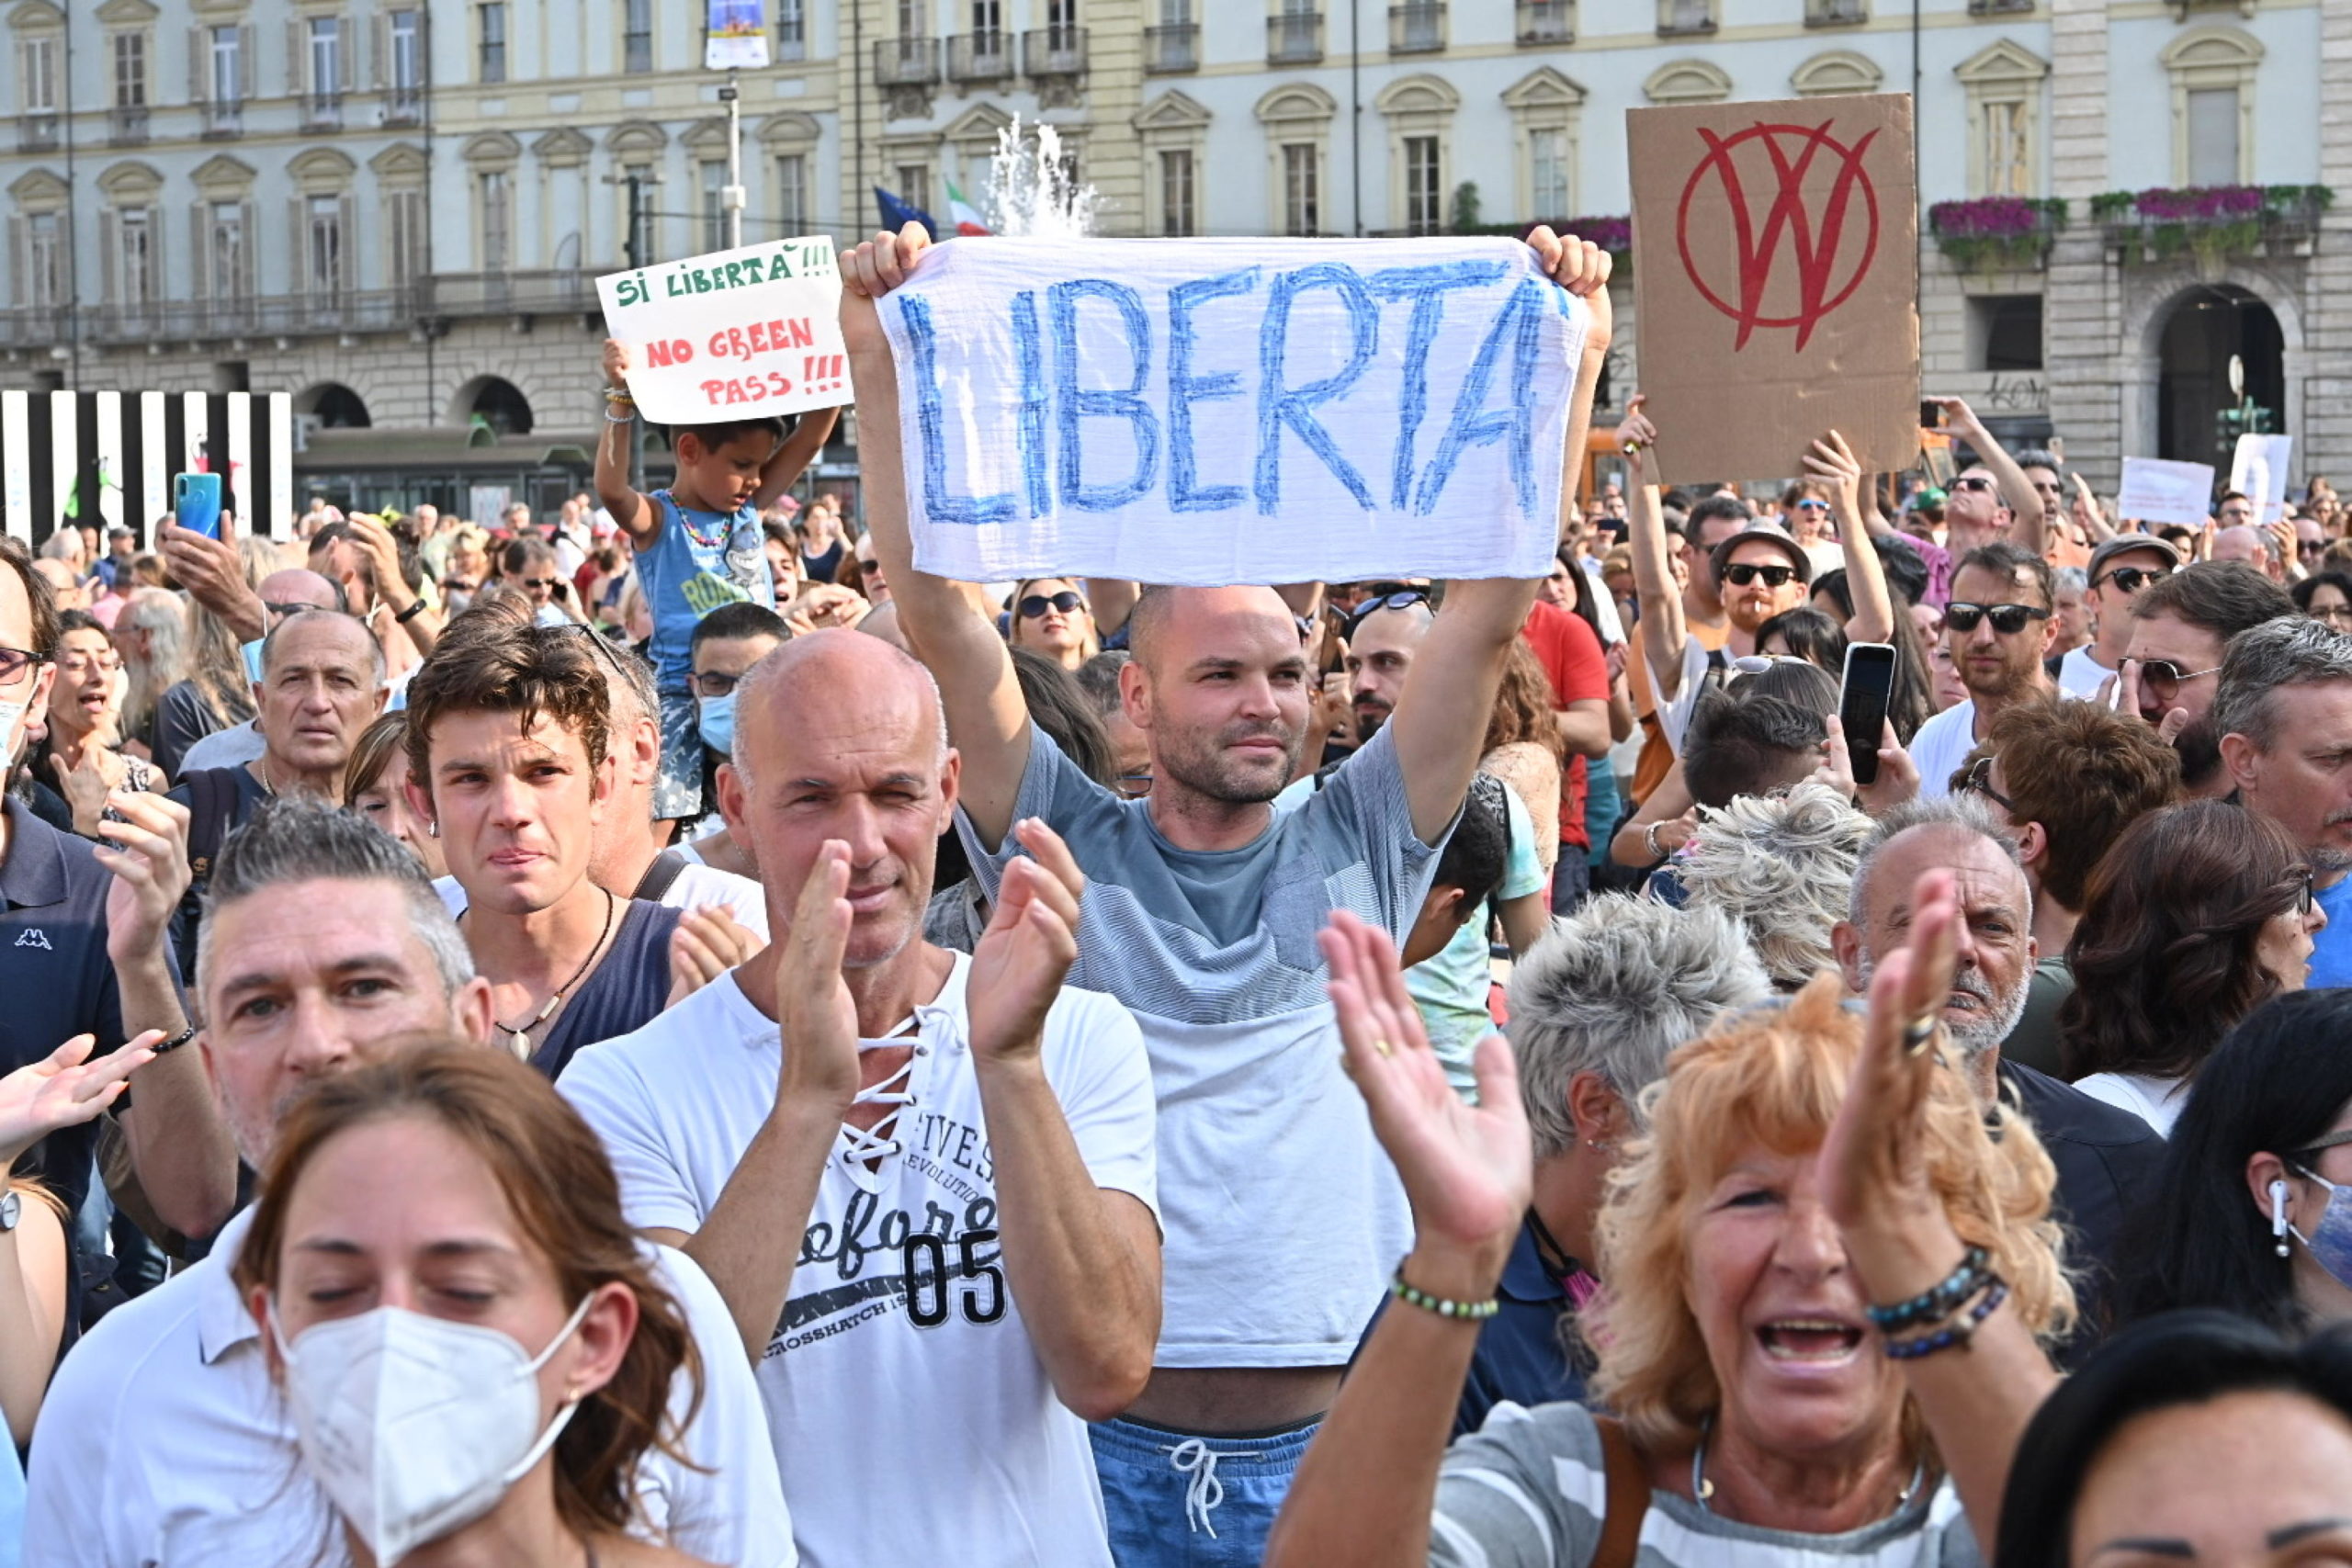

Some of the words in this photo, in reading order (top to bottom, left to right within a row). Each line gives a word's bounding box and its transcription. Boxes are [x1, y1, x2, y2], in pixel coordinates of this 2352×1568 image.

[646, 338, 695, 368] NO
[707, 317, 814, 362] GREEN
[699, 371, 792, 405] PASS
[918, 1112, 994, 1183] IVES
[902, 1229, 1006, 1326] 05
